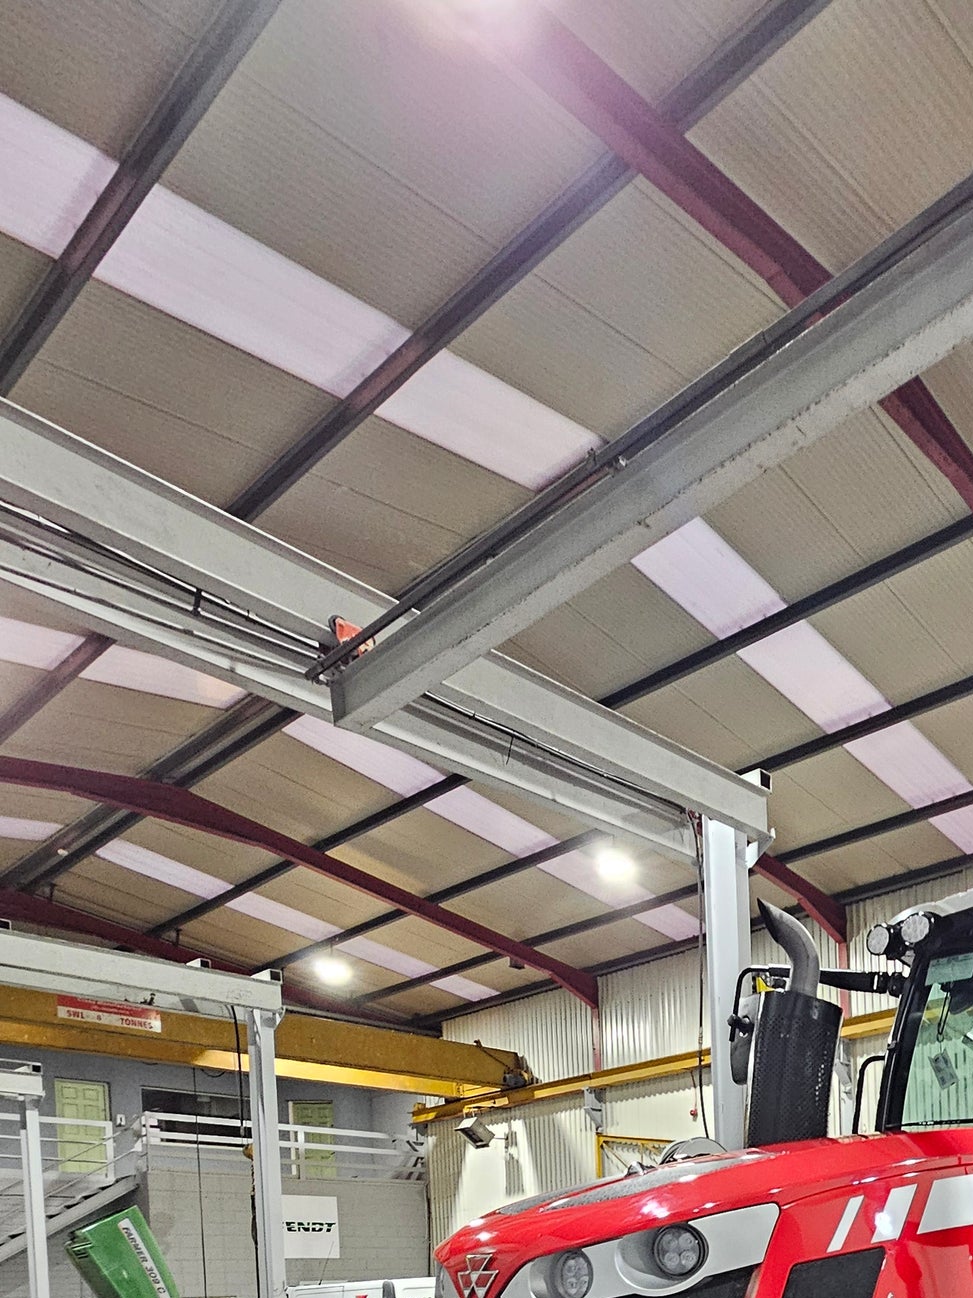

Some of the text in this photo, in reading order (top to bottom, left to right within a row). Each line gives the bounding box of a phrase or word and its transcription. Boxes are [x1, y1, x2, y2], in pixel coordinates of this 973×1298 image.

[66, 1009, 85, 1020] SWL
[119, 1017, 153, 1030] TONNES
[282, 1221, 336, 1233] ENDT
[121, 1226, 148, 1263] FARMER
[156, 1286, 166, 1294] C
